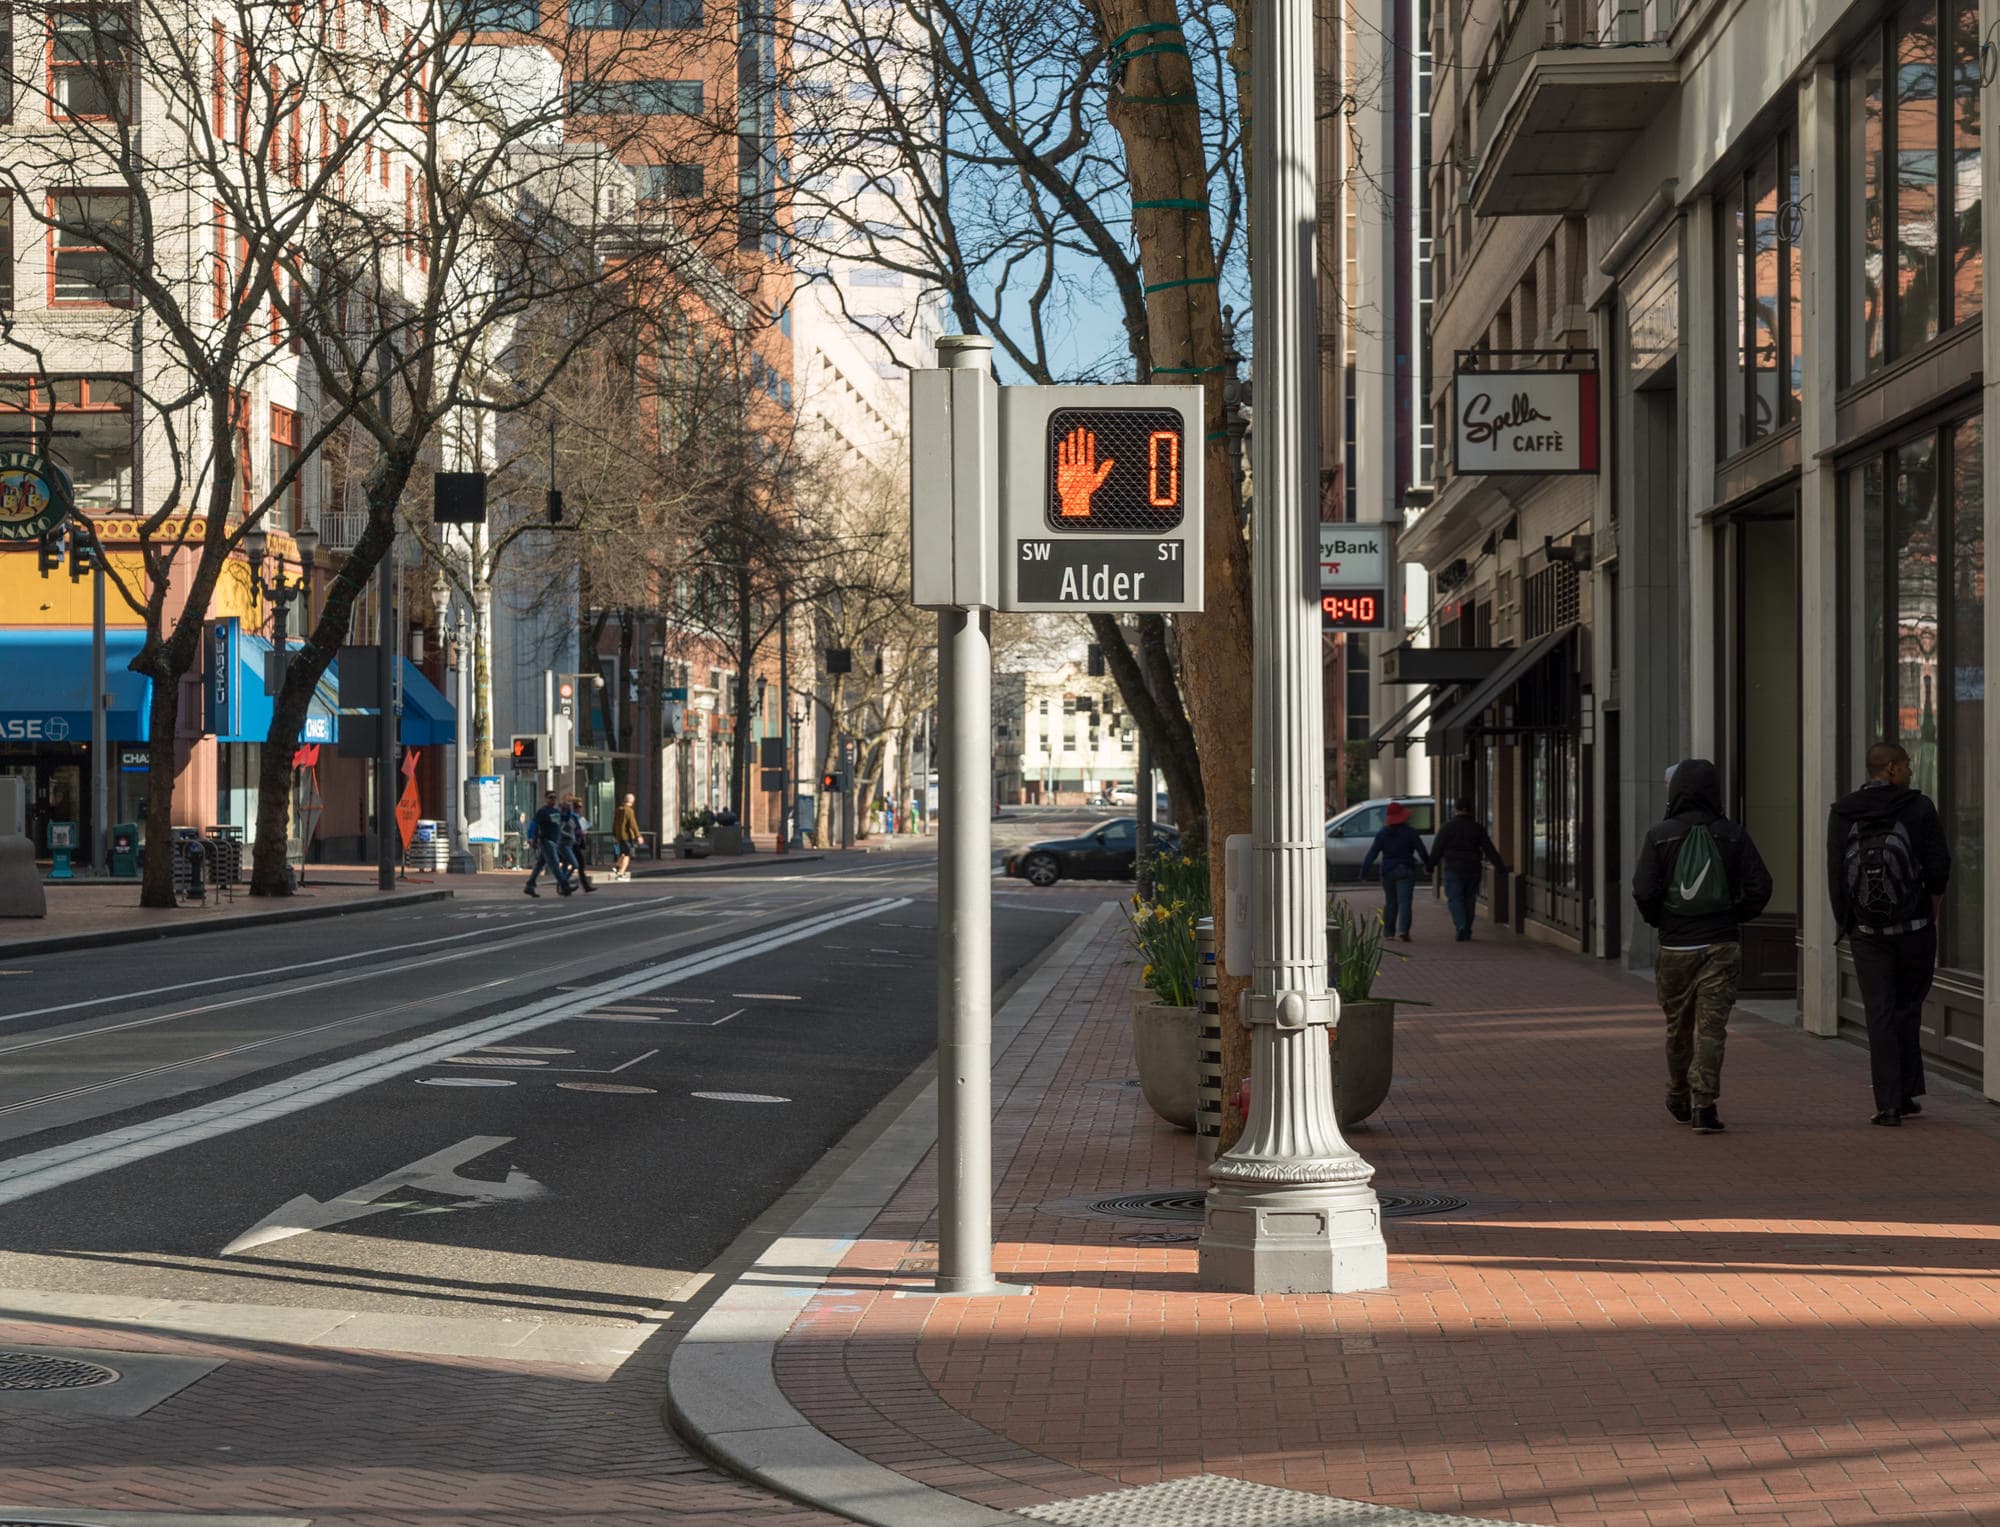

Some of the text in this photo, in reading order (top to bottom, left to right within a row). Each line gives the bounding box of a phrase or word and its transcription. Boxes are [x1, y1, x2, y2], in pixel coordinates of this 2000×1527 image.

[1463, 393, 1551, 451] Spella
[1513, 431, 1563, 452] CAFFÈ
[0, 516, 51, 539] NACO
[1022, 543, 1179, 561] SW ST
[1059, 564, 1145, 601] Alder
[1322, 597, 1375, 621] 9:40
[216, 641, 225, 704] CHASE
